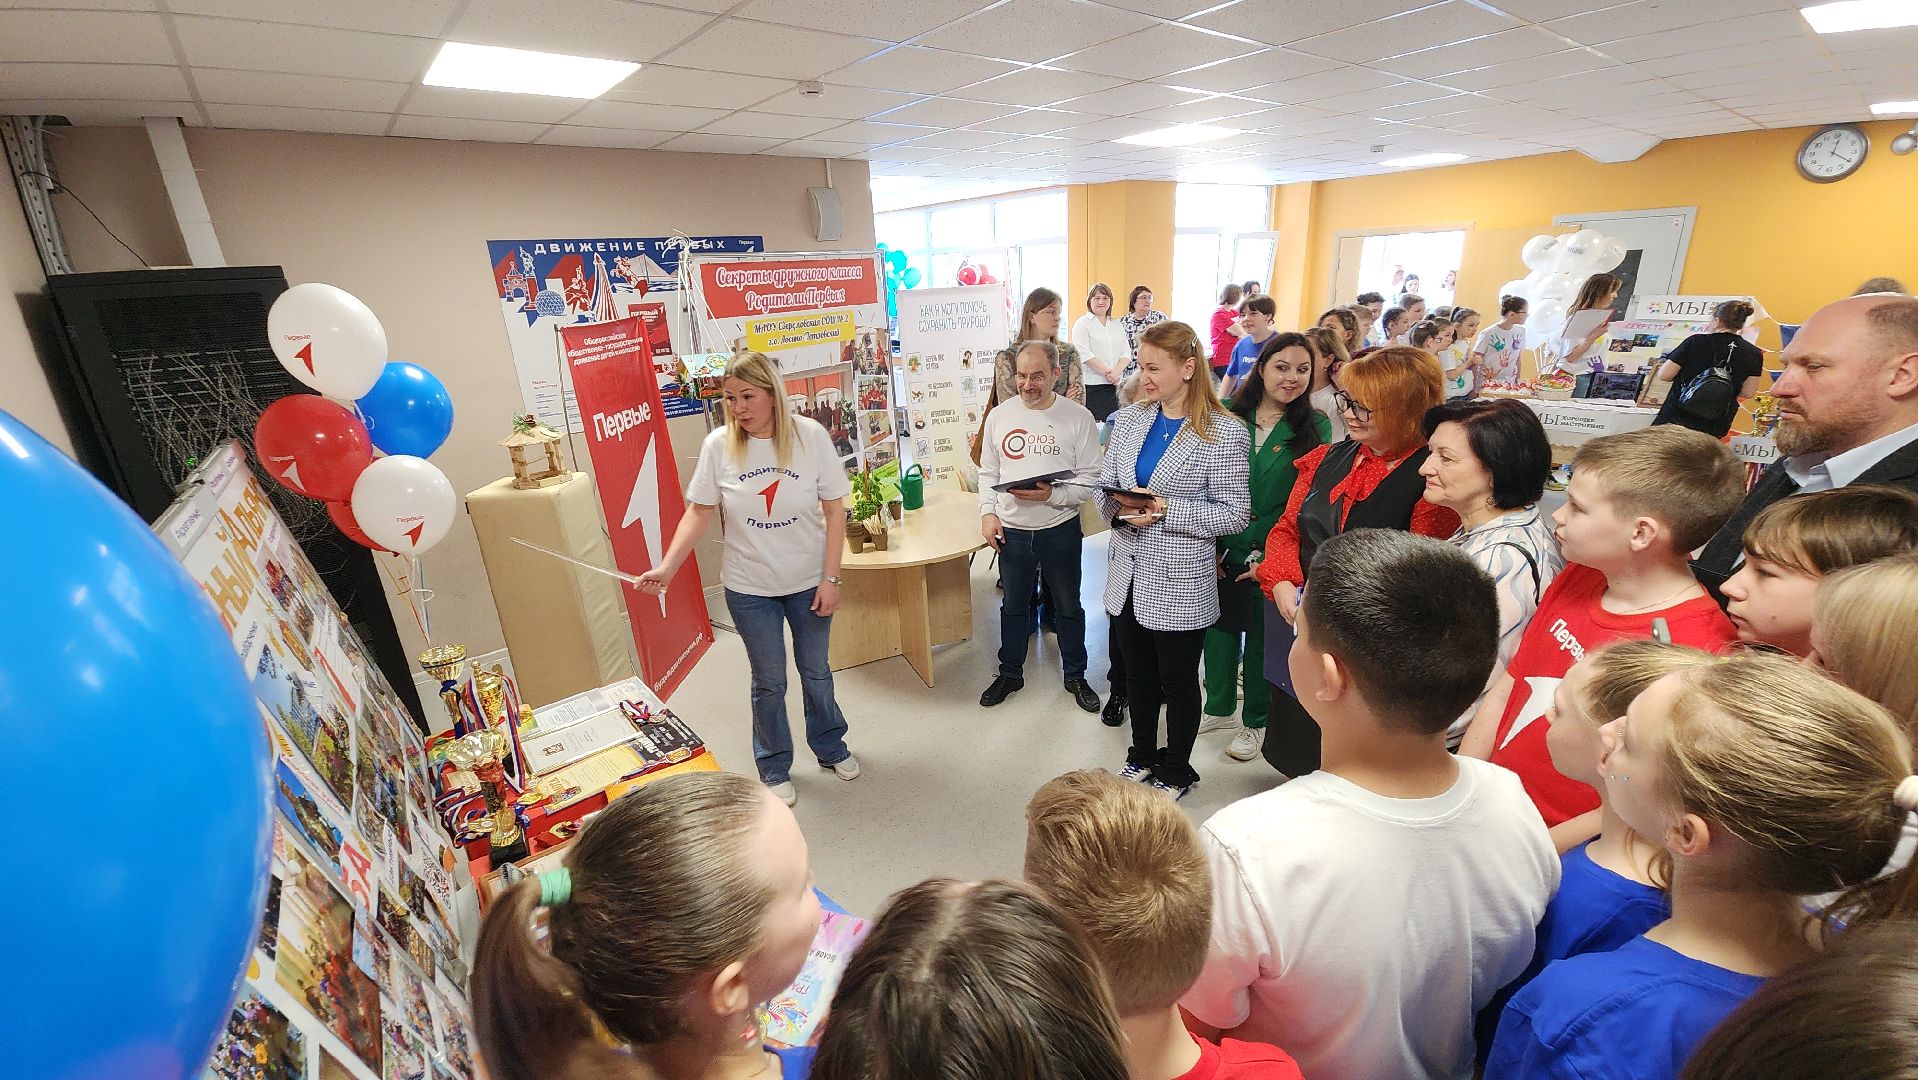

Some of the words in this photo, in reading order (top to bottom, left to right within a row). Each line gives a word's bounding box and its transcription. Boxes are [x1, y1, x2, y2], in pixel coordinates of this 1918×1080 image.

[534, 241, 646, 255] ДВИЖЕНИЕ
[716, 265, 772, 292] Секреты
[773, 267, 828, 289] дружного
[828, 265, 863, 281] класса
[745, 289, 806, 314] Родители
[806, 285, 846, 308] Первых
[1663, 301, 1709, 316] МЫ
[1690, 325, 1711, 333] КЛА
[593, 401, 652, 442] Первые
[1741, 444, 1777, 458] МЫ
[746, 515, 799, 530] Первых
[1549, 617, 1586, 662] Первы
[791, 983, 811, 995] ГРА
